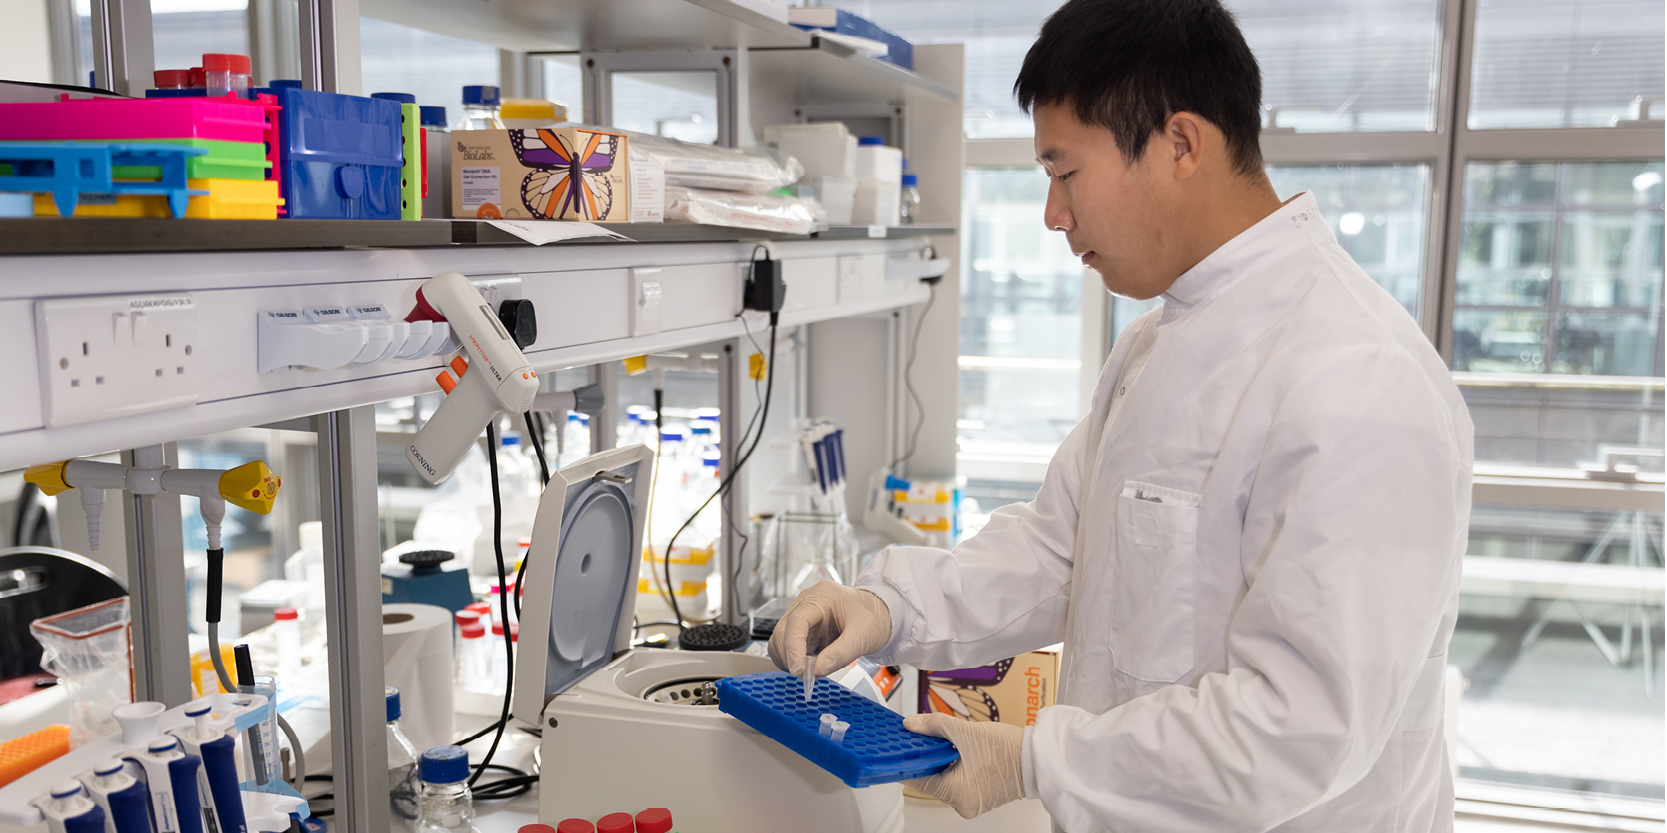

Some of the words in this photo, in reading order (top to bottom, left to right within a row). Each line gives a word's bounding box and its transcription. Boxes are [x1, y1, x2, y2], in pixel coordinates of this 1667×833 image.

[489, 365, 502, 382] ULTRA
[409, 444, 437, 476] CORNING
[1024, 666, 1040, 726] onarch
